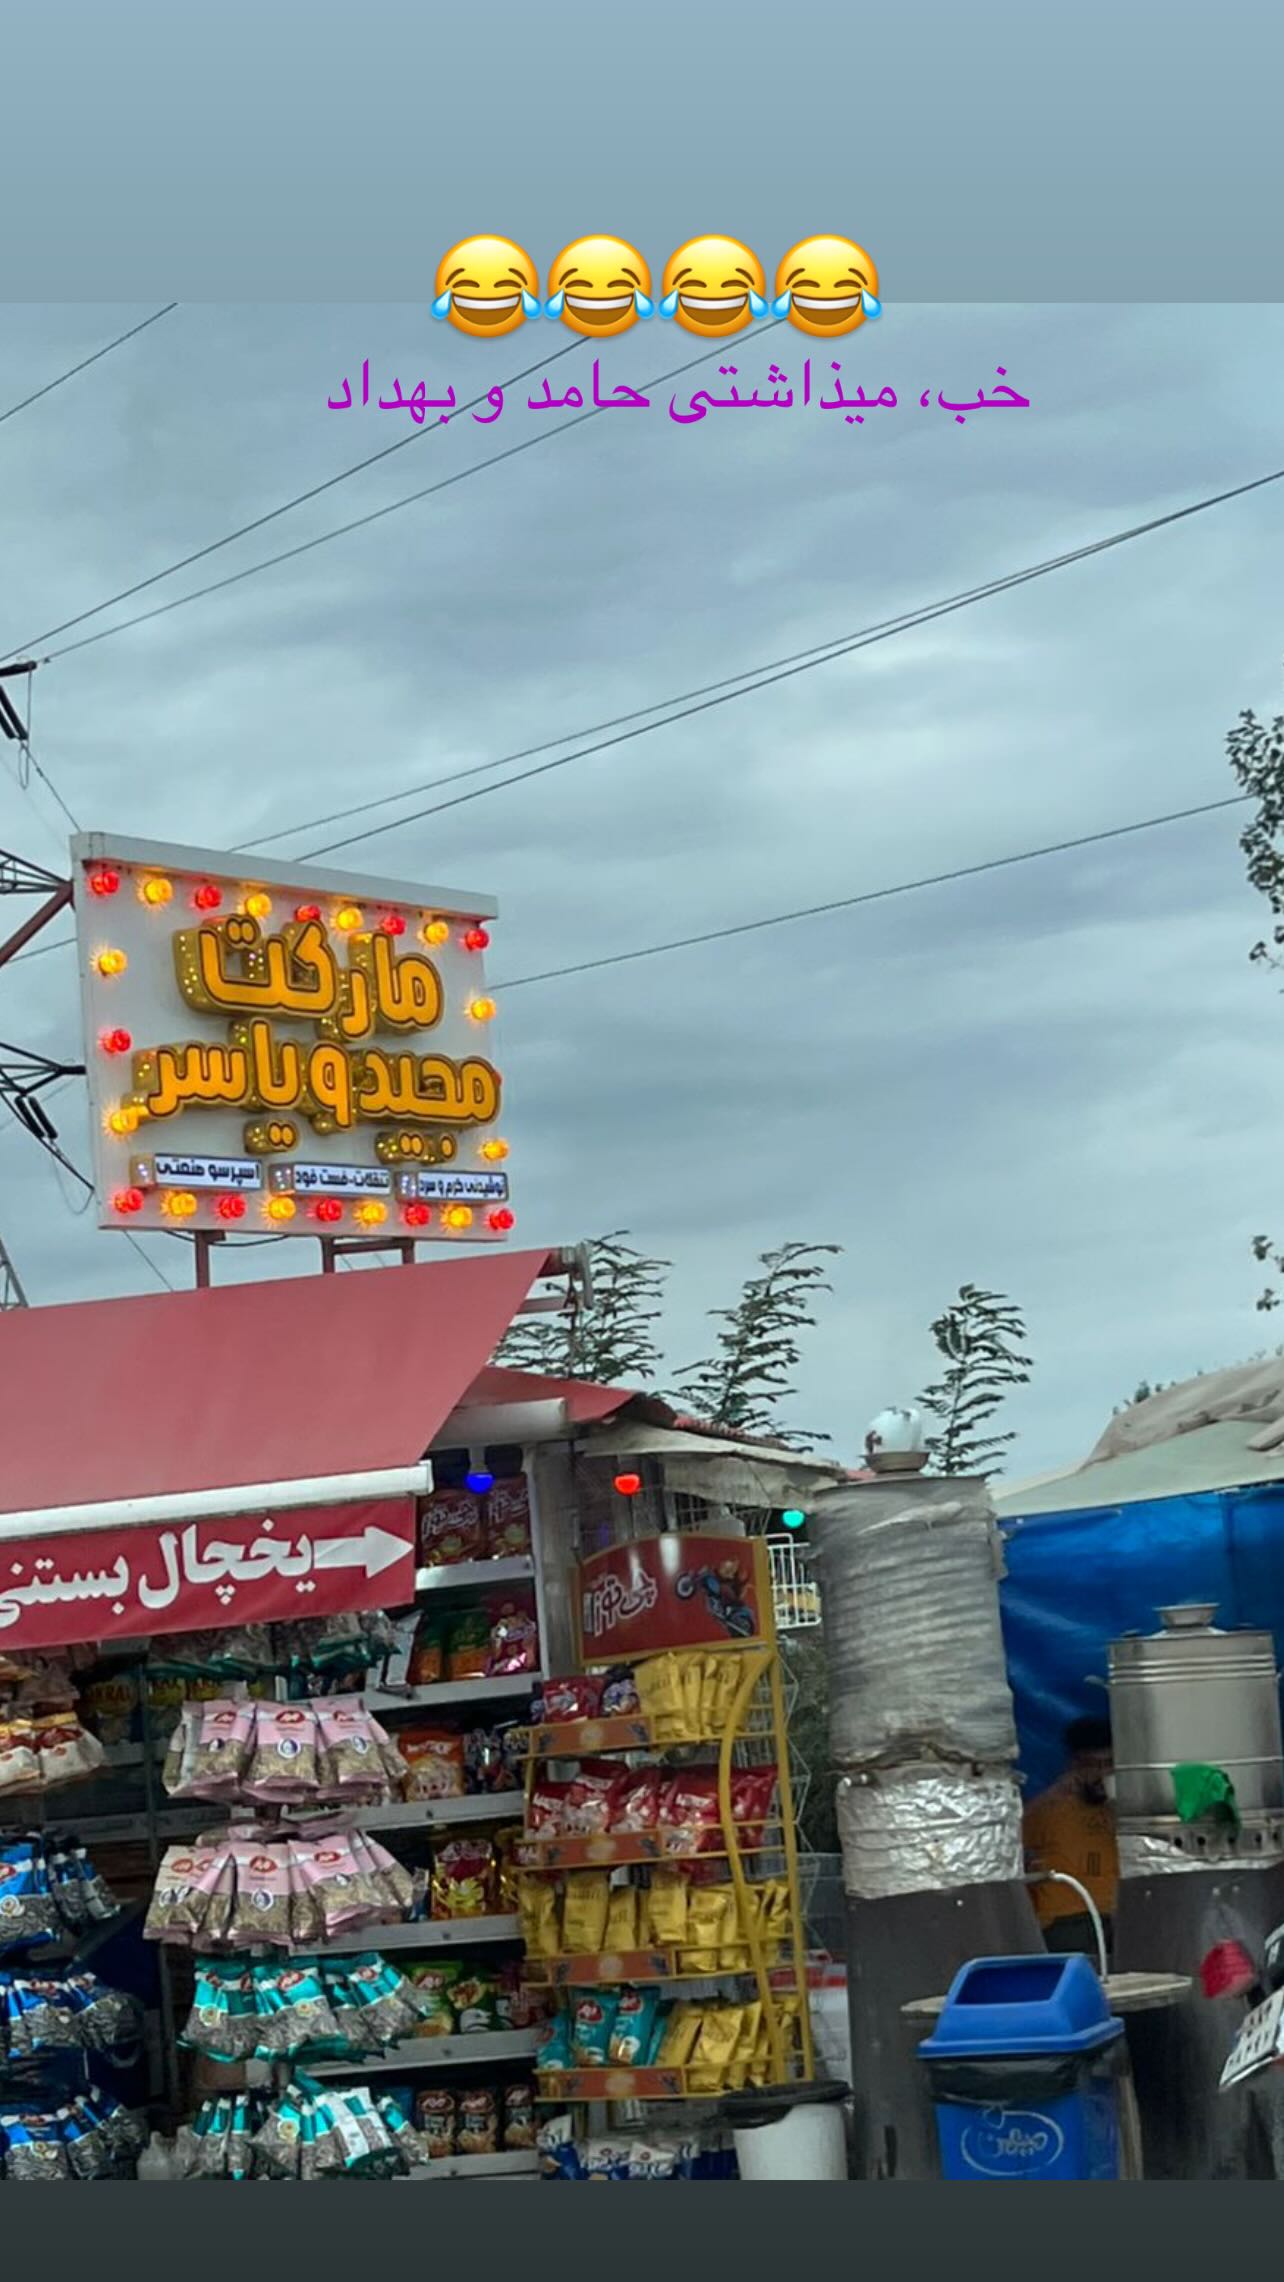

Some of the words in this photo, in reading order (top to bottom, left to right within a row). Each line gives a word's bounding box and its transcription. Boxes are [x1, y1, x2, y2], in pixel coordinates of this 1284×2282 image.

[196, 912, 444, 1038] مارکت
[147, 1018, 301, 1151] یاسر
[359, 1052, 500, 1158] مجید
[155, 1158, 206, 1178] صنعتی
[207, 1164, 260, 1187] اسپرسو
[295, 1167, 318, 1188] فود
[137, 1518, 316, 1610] یخچال
